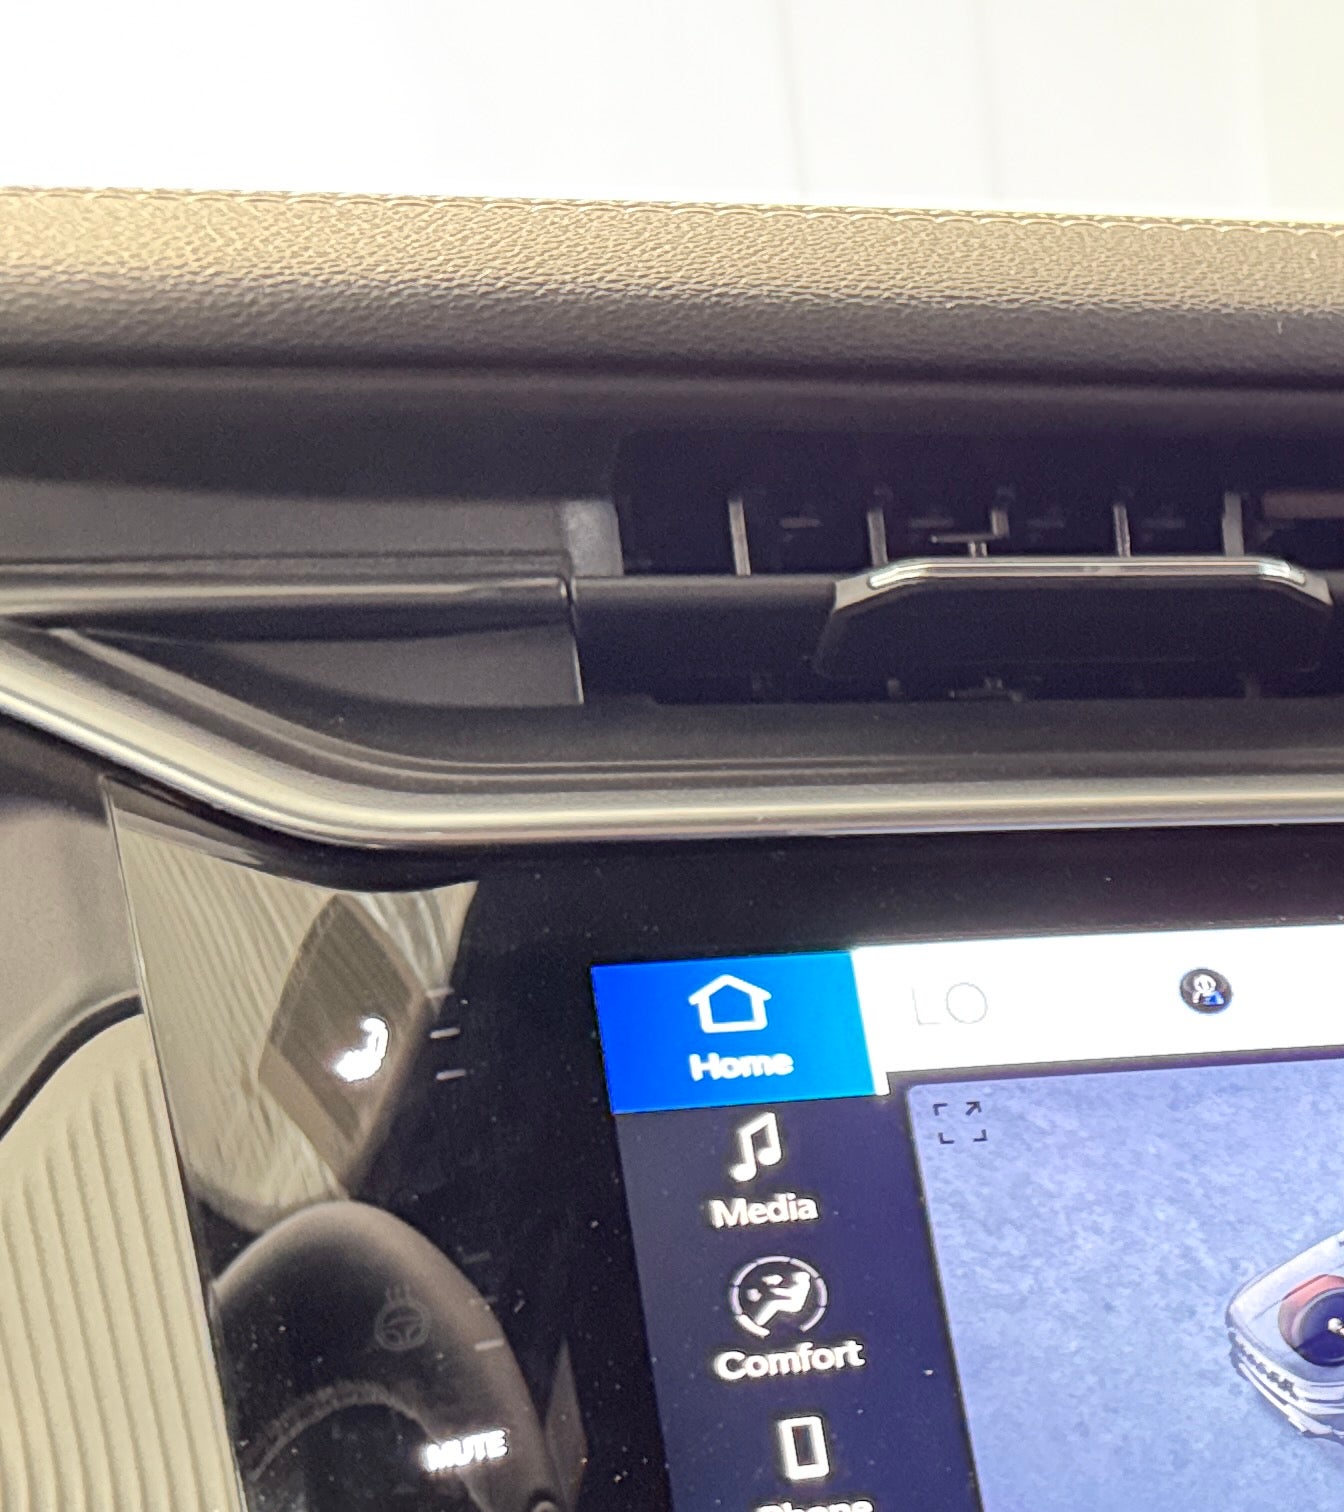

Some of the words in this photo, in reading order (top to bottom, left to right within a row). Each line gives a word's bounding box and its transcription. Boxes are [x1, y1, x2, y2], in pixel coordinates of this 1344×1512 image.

[910, 981, 989, 1027] LO
[687, 1050, 795, 1083] Home
[709, 1191, 819, 1229] Media
[713, 1340, 867, 1382] Comfort
[424, 1428, 510, 1473] MUTE
